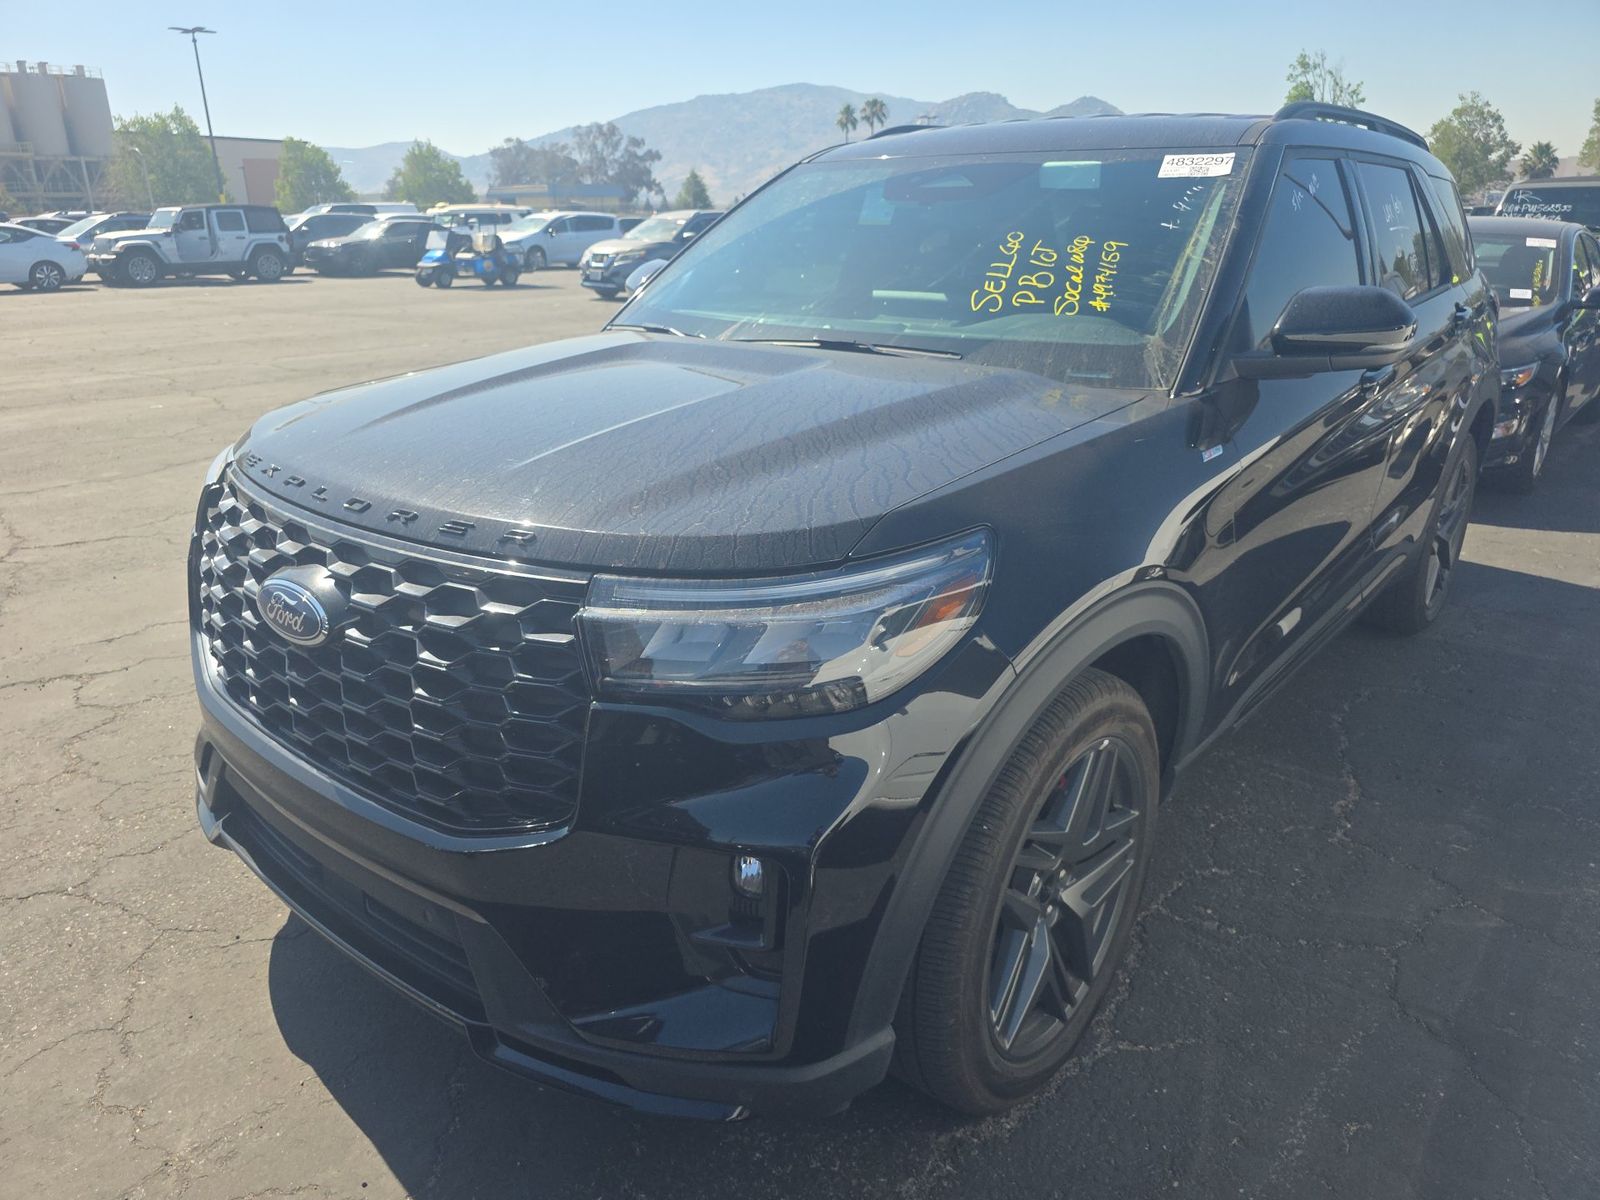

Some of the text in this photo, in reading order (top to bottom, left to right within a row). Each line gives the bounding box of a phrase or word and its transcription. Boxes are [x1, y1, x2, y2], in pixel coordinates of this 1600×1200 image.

[1166, 156, 1234, 167] 4832297
[244, 453, 538, 544] EXPLORER
[266, 591, 307, 633] Ford
